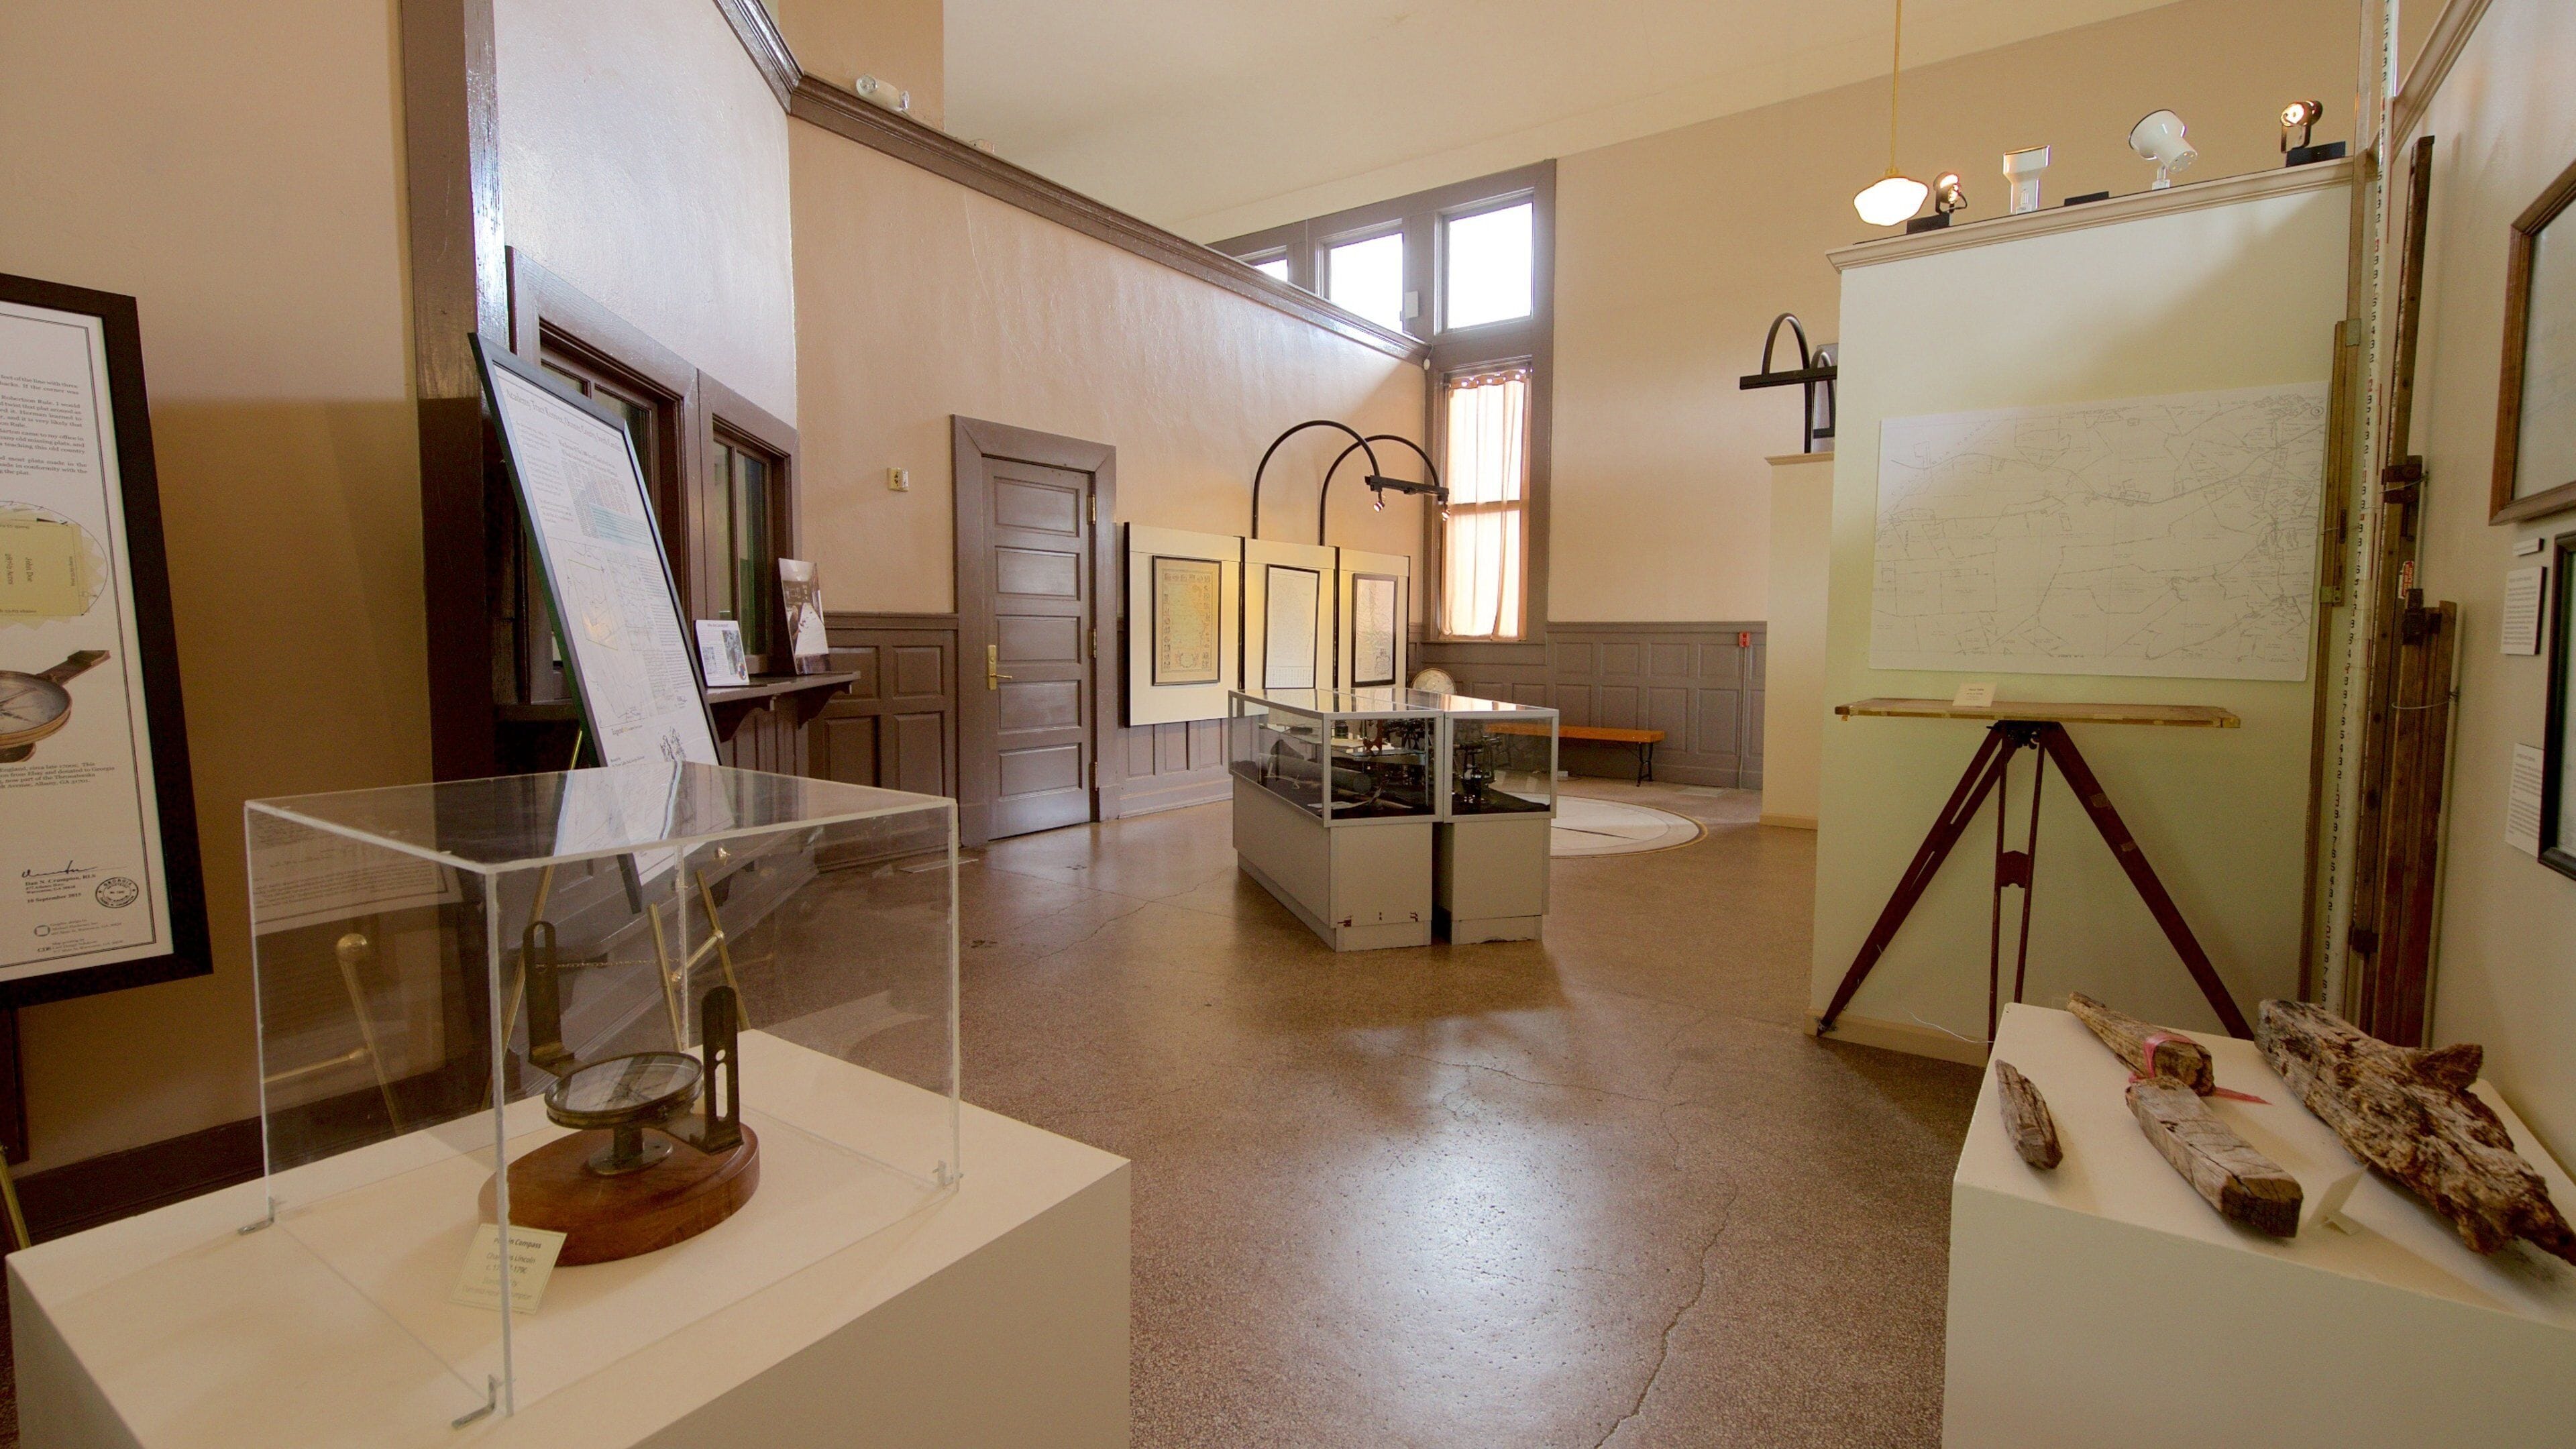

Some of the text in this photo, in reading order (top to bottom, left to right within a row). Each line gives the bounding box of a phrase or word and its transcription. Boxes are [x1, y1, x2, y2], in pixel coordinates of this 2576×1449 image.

[2382, 57, 2387, 67] 3
[2381, 71, 2387, 81] 2
[2375, 213, 2381, 223] 2
[2370, 339, 2375, 350] 3
[2369, 353, 2374, 364] 2
[2365, 431, 2369, 440] 3
[5, 441, 34, 449] teaching
[2363, 445, 2369, 454] 2
[2340, 730, 2345, 739] 5
[2339, 757, 2343, 766] 3
[2337, 770, 2342, 780] 2
[36, 894, 66, 903] September
[2328, 901, 2332, 911] 2
[515, 1238, 542, 1250] Compass
[515, 1254, 536, 1265] Lincoln
